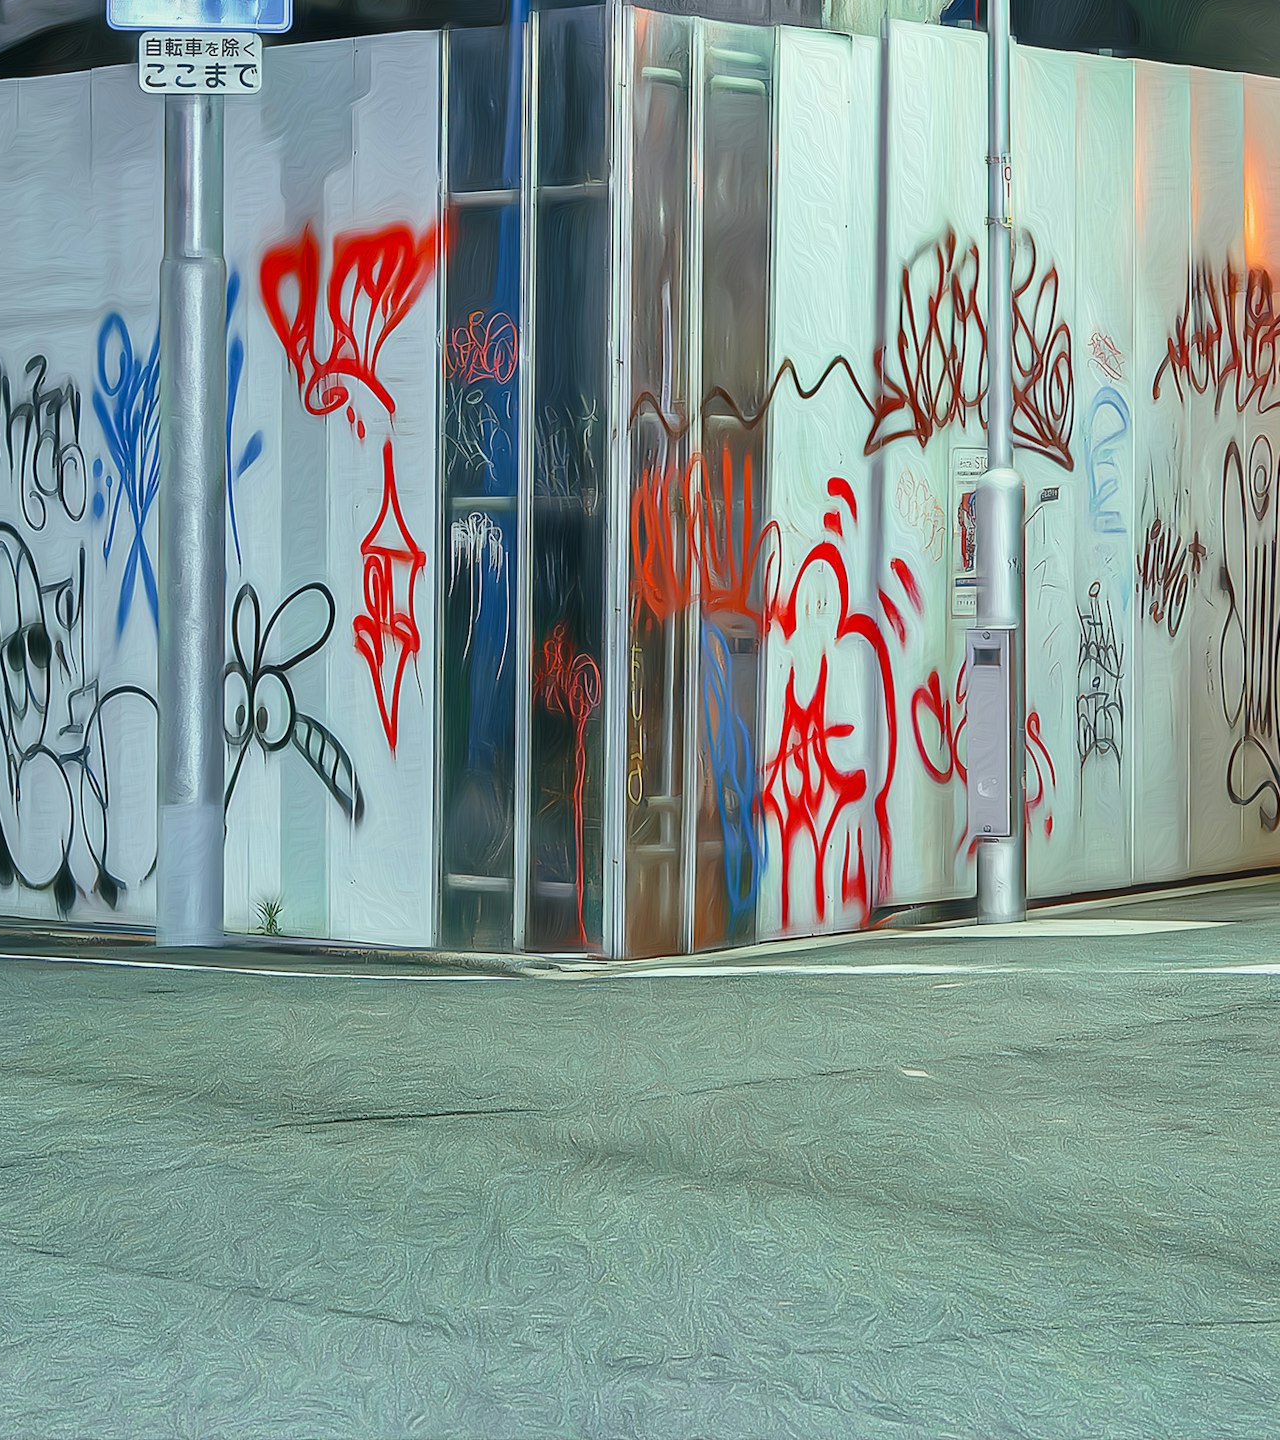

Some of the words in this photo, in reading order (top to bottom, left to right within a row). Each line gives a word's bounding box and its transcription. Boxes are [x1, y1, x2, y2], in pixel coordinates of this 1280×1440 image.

[146, 38, 255, 57] 自転車を除く
[145, 63, 257, 88] ここまで
